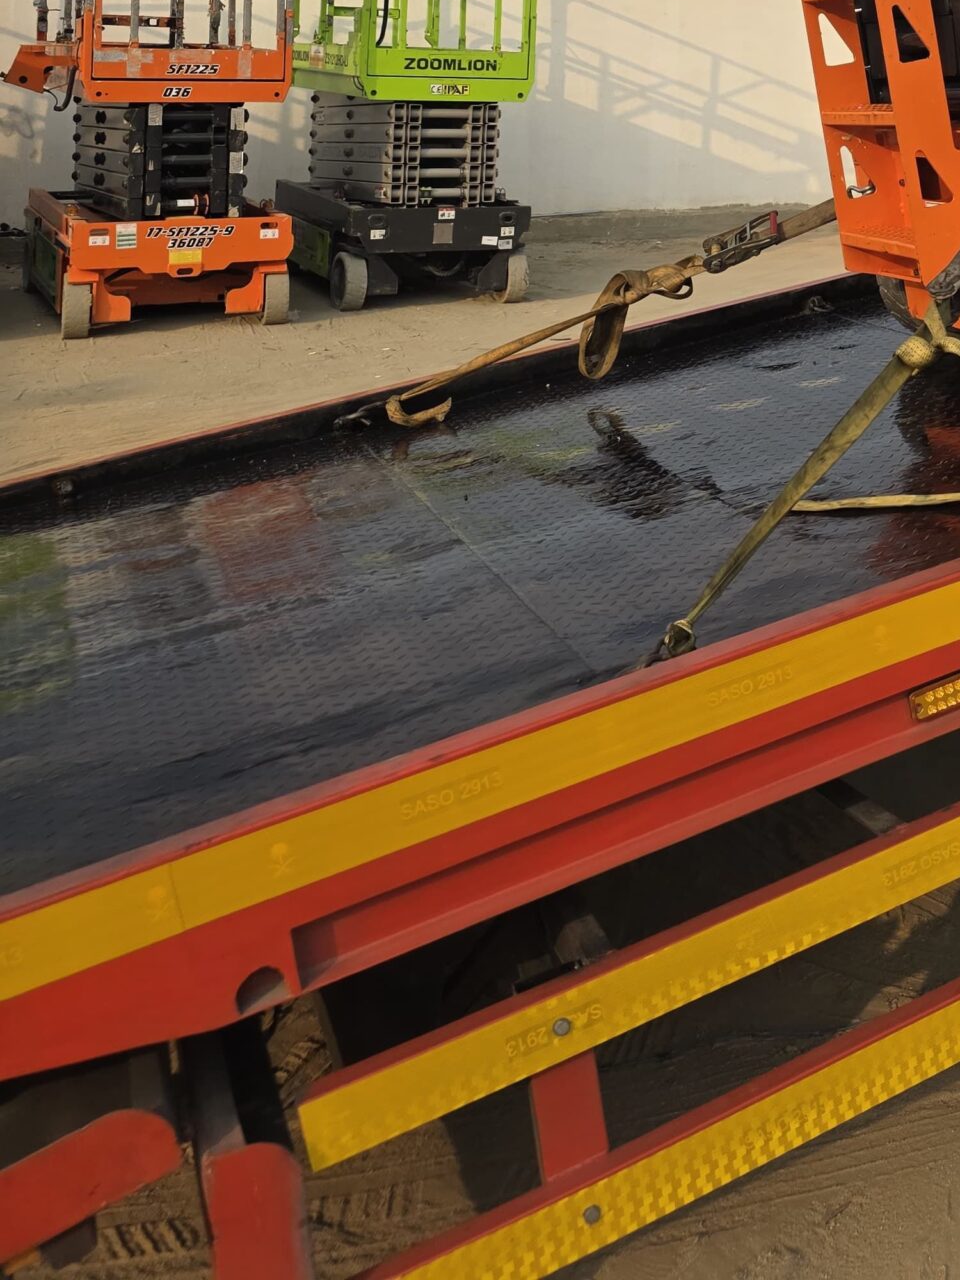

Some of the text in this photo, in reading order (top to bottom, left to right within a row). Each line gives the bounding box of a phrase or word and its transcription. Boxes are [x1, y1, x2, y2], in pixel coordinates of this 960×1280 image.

[165, 63, 220, 76] SF1225
[403, 57, 498, 72] ZOOMLION
[162, 86, 192, 98] 036
[146, 224, 235, 238] 17-SF1225-9
[707, 664, 793, 707] SASO 2913
[401, 771, 504, 820] SASO 2913
